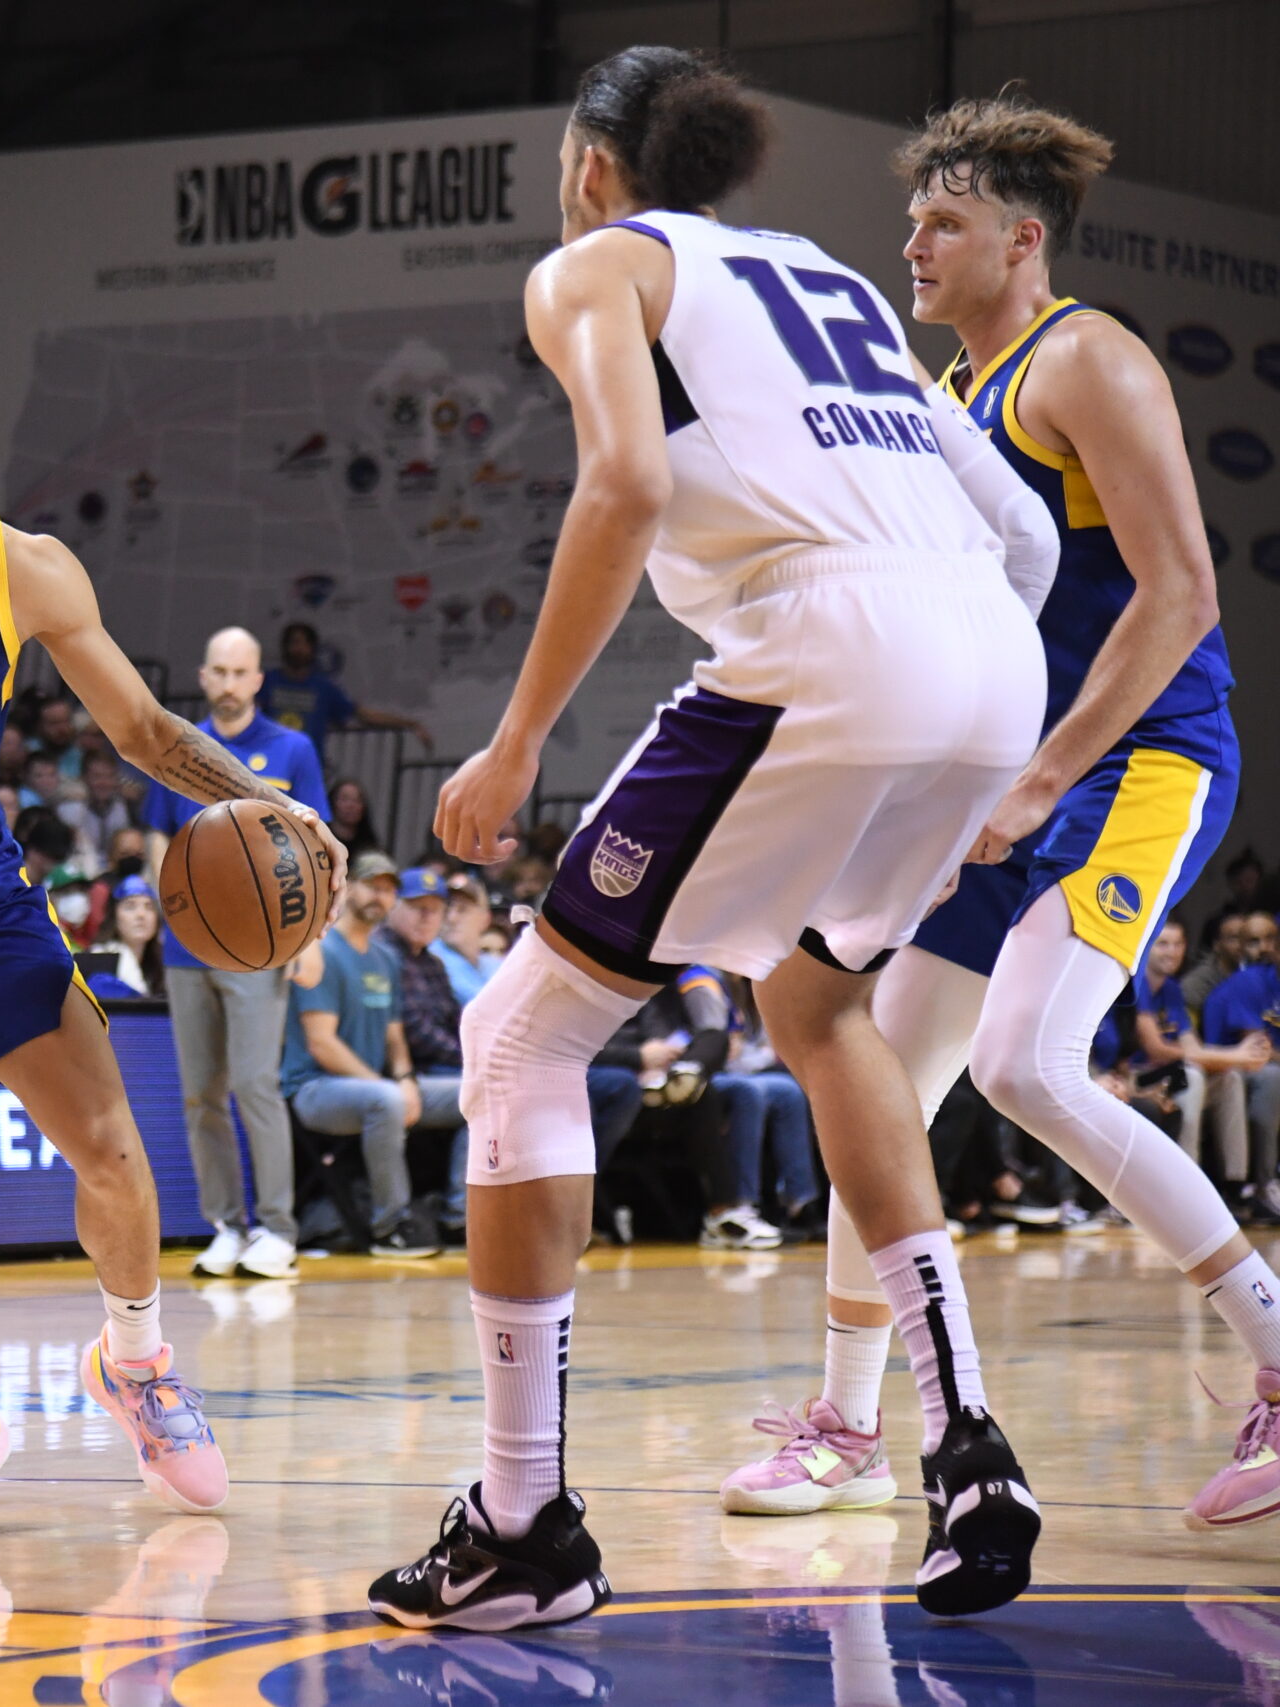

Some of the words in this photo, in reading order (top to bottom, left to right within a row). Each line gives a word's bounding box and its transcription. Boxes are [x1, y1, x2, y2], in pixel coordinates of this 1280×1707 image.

[214, 160, 297, 245] NBA
[368, 141, 517, 232] LEAGUE
[1081, 223, 1156, 272] SUITE
[721, 255, 932, 408] 12
[595, 852, 641, 882] KINGS
